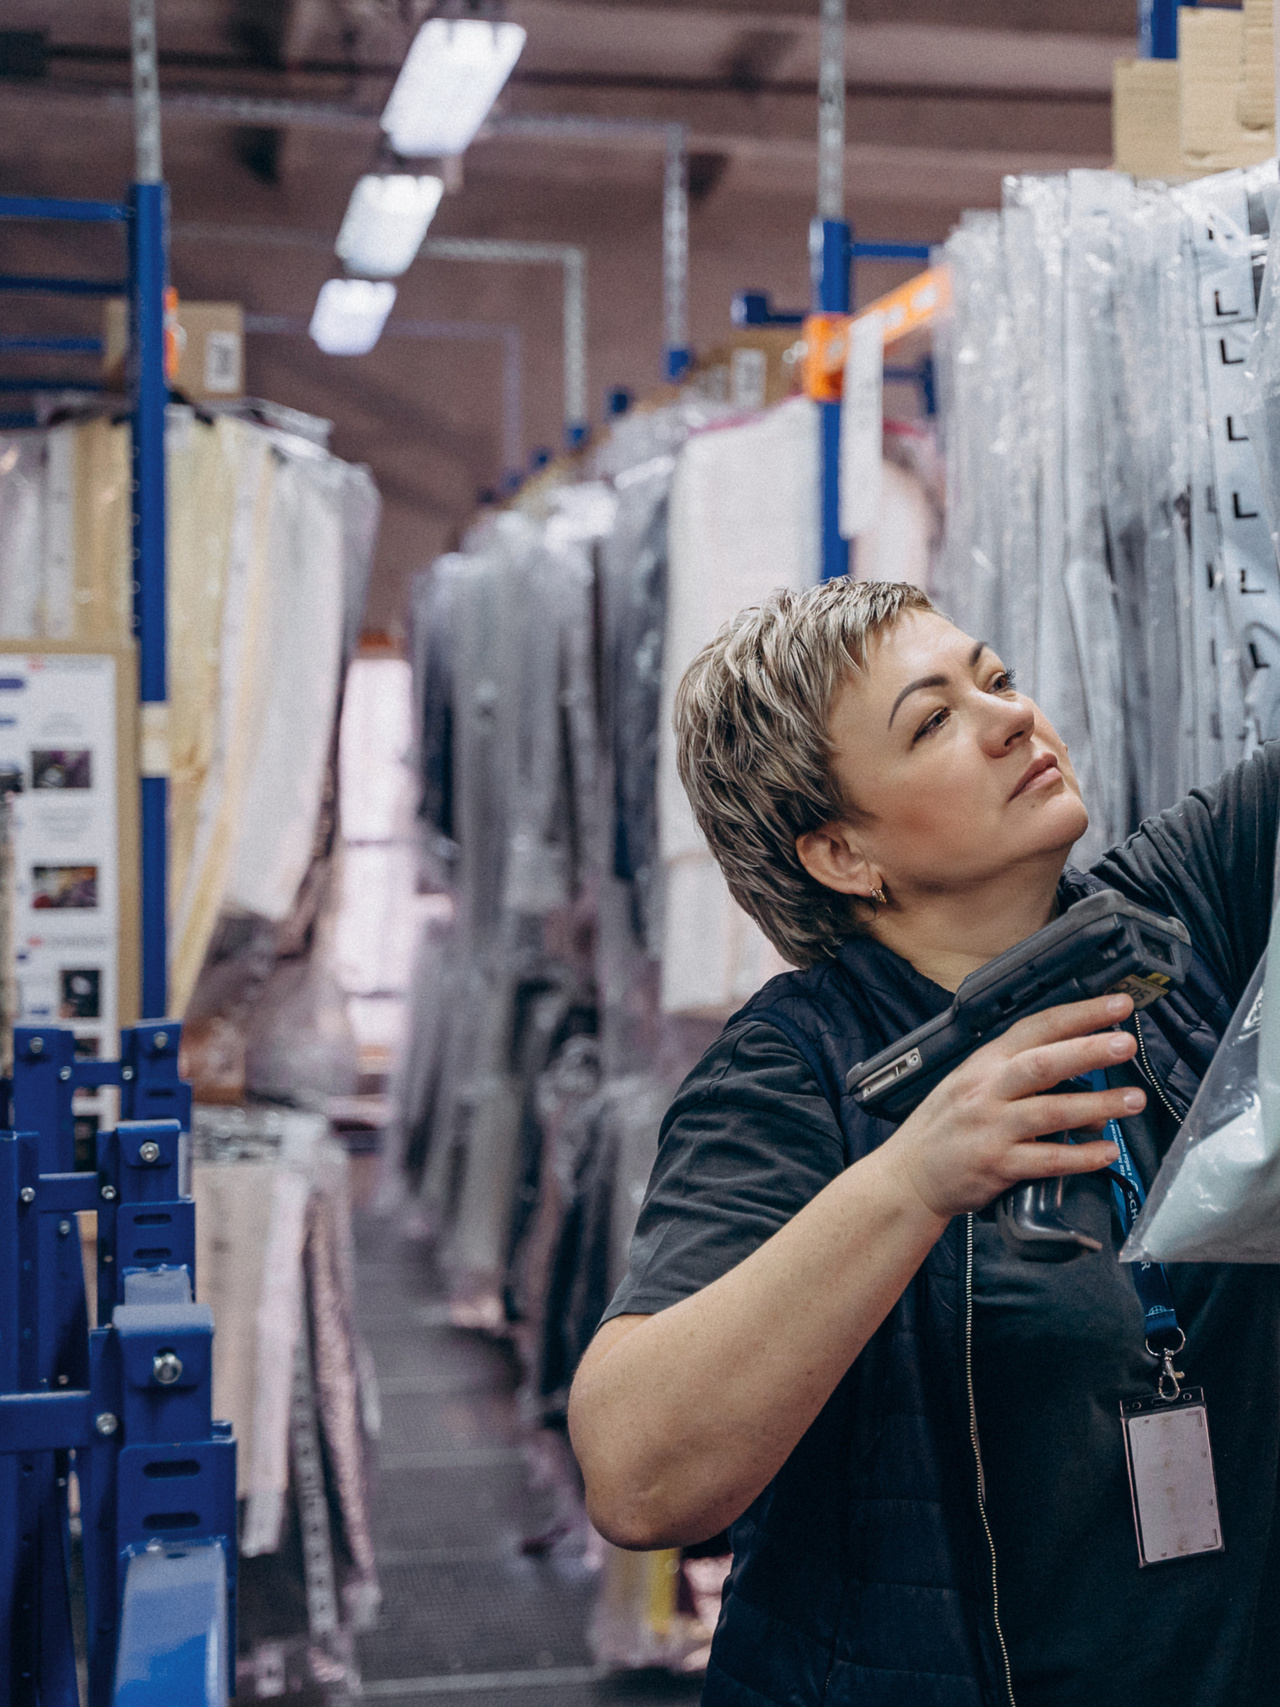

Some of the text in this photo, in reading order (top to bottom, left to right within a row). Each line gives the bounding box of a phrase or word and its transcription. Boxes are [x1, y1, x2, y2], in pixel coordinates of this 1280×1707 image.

[1214, 290, 1239, 316] L
[1220, 339, 1244, 365] L
[1227, 416, 1249, 441] L
[1233, 493, 1258, 519] L
[1241, 569, 1265, 594] L
[1250, 643, 1270, 668] L
[1127, 1190, 1150, 1271] SCHR
